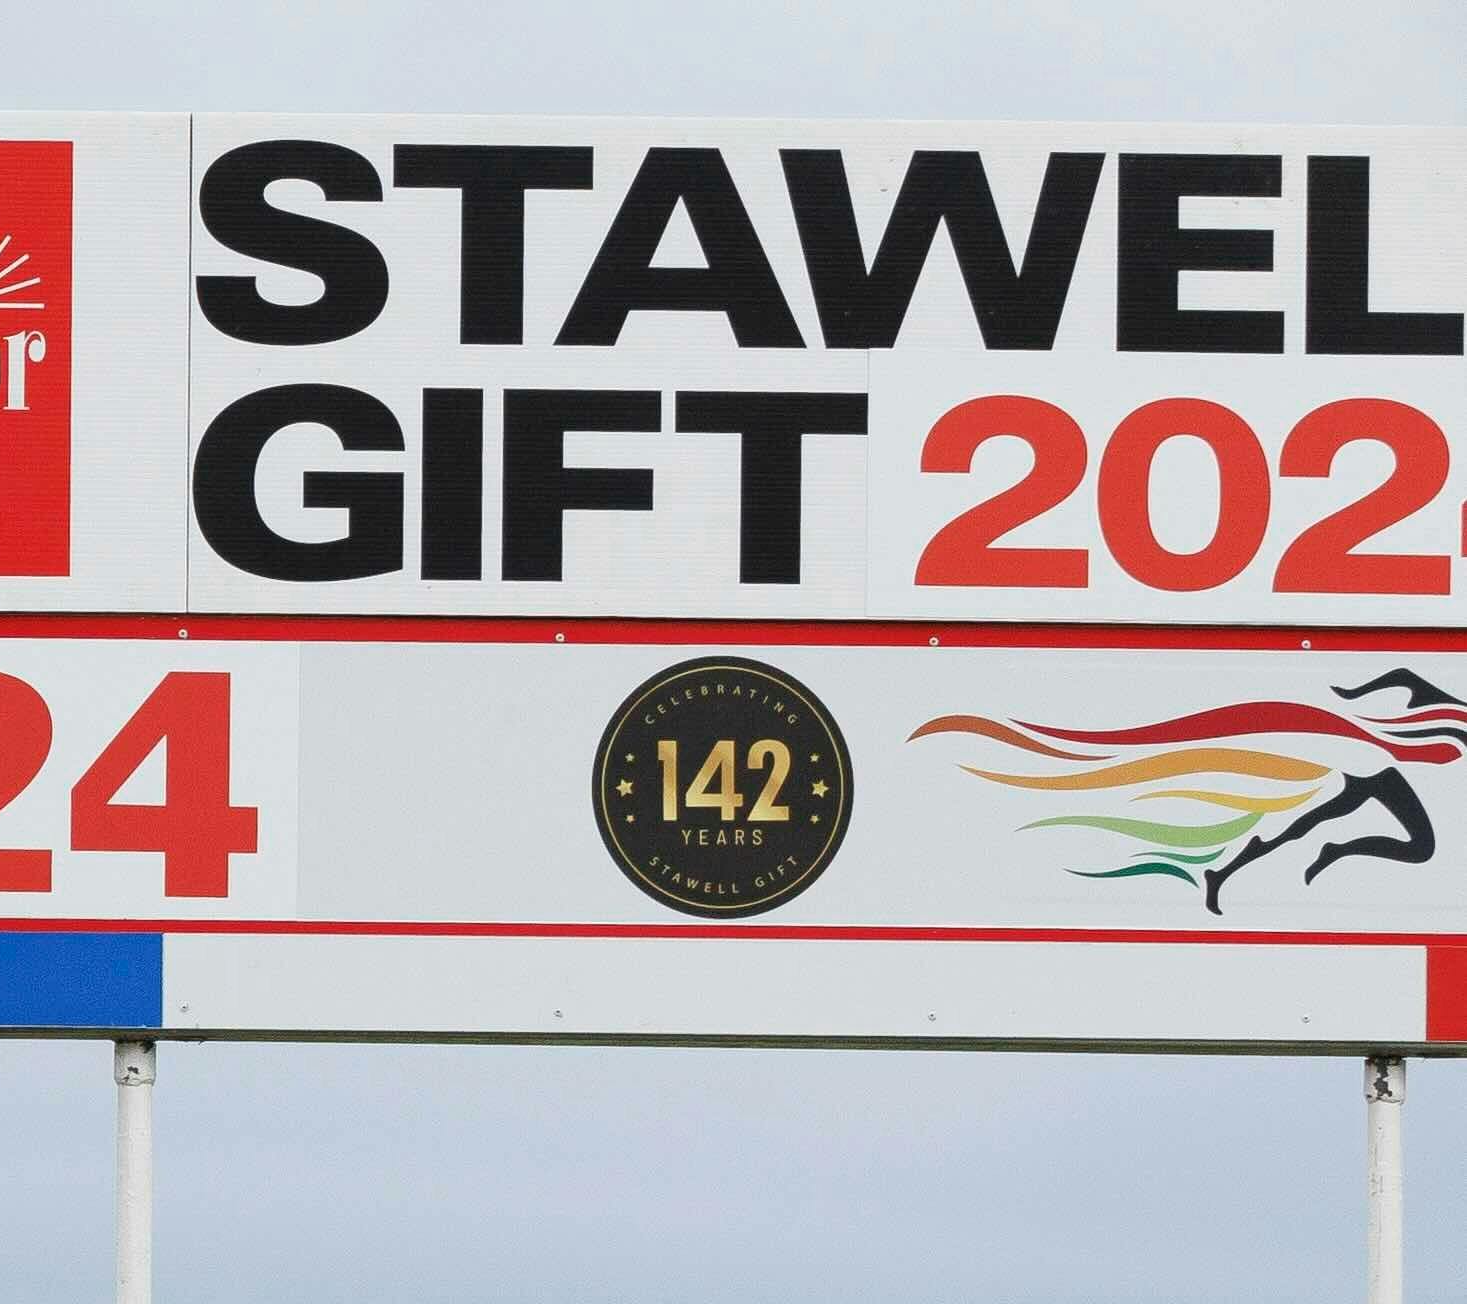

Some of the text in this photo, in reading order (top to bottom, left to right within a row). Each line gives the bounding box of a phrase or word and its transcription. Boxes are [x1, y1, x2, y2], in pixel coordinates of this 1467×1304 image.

[194, 384, 1467, 596] GIFT 202
[644, 684, 799, 727] CELEBRATING
[657, 739, 791, 822] 142
[681, 829, 764, 846] YEARS
[649, 856, 799, 894] STAWELL GIFT
